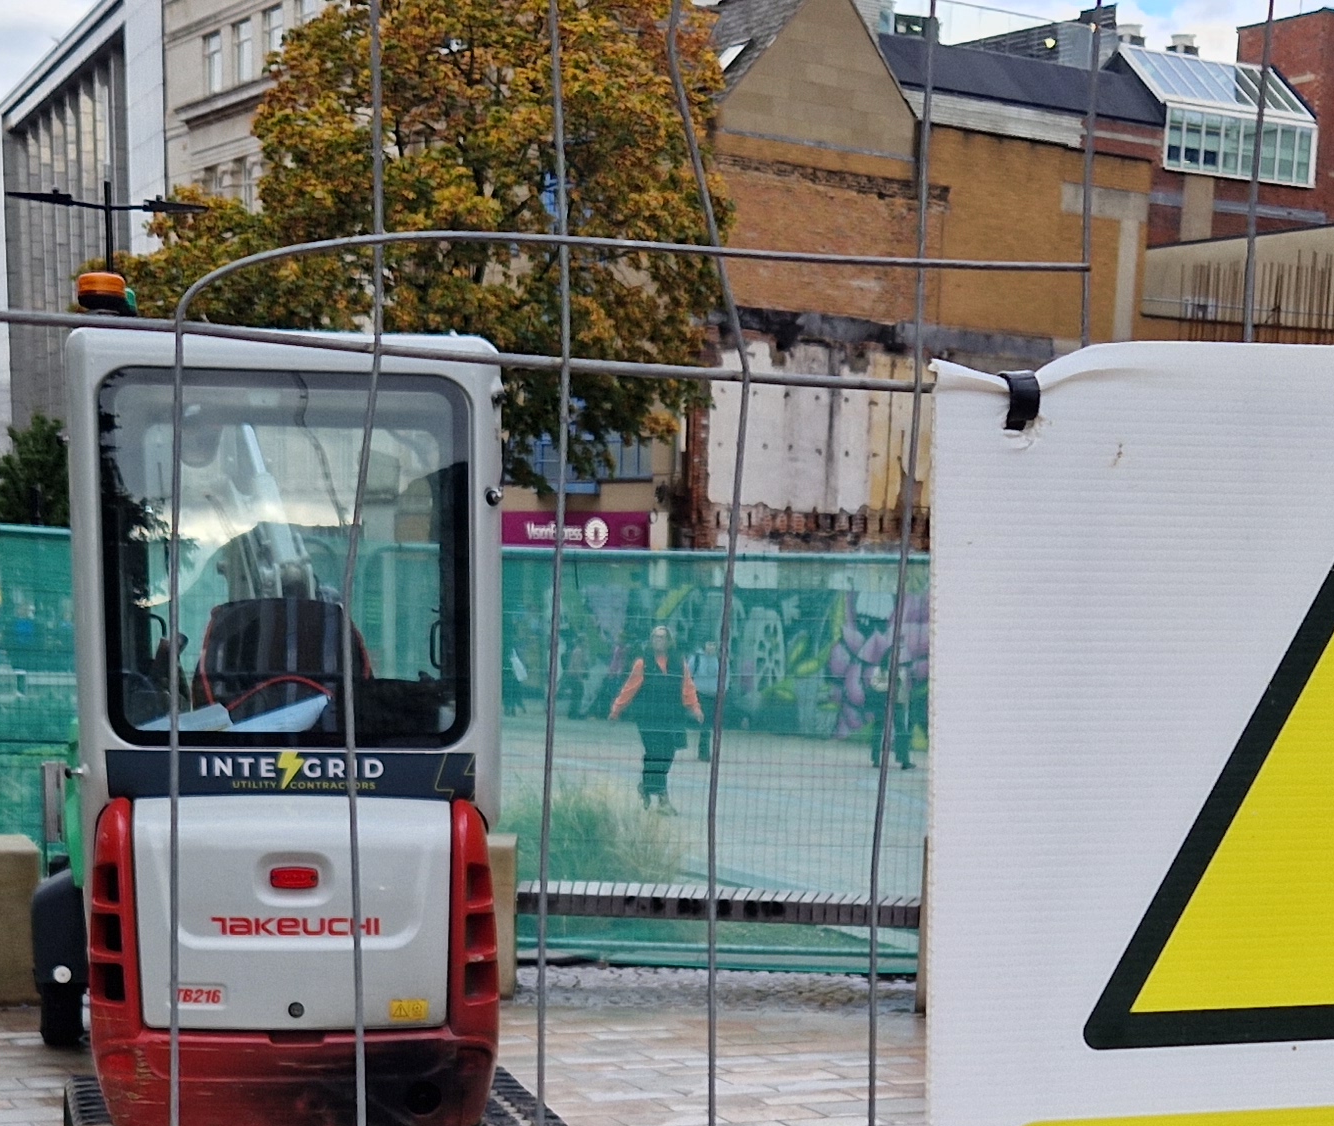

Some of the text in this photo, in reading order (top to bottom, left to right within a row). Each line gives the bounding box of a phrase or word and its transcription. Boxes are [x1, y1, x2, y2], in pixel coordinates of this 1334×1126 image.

[232, 780, 376, 790] UTILITY CONTRACORS
[176, 988, 222, 1005] TB216
